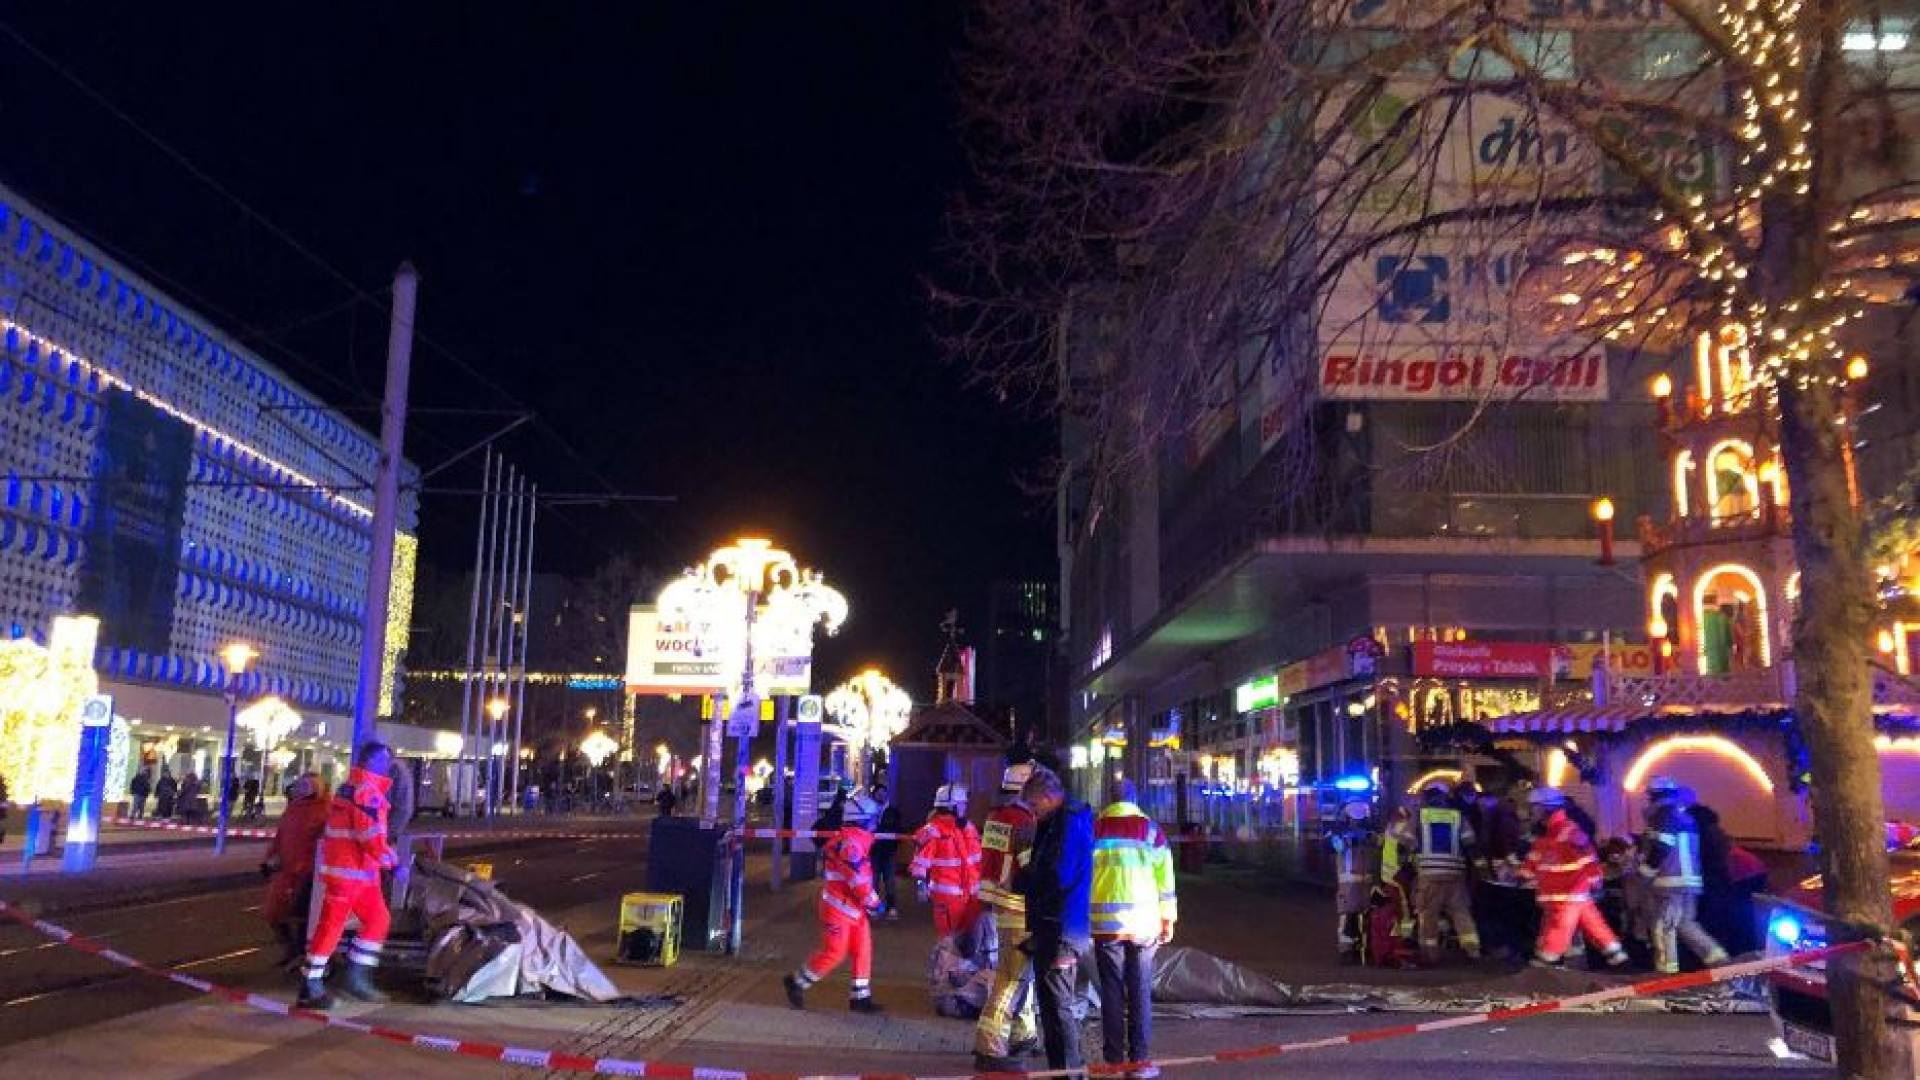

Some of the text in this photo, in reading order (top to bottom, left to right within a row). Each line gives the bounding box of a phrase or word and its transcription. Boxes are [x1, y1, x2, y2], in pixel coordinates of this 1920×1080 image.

[1480, 118, 1567, 165] dm
[1323, 353, 1602, 392] Bingöl Grill
